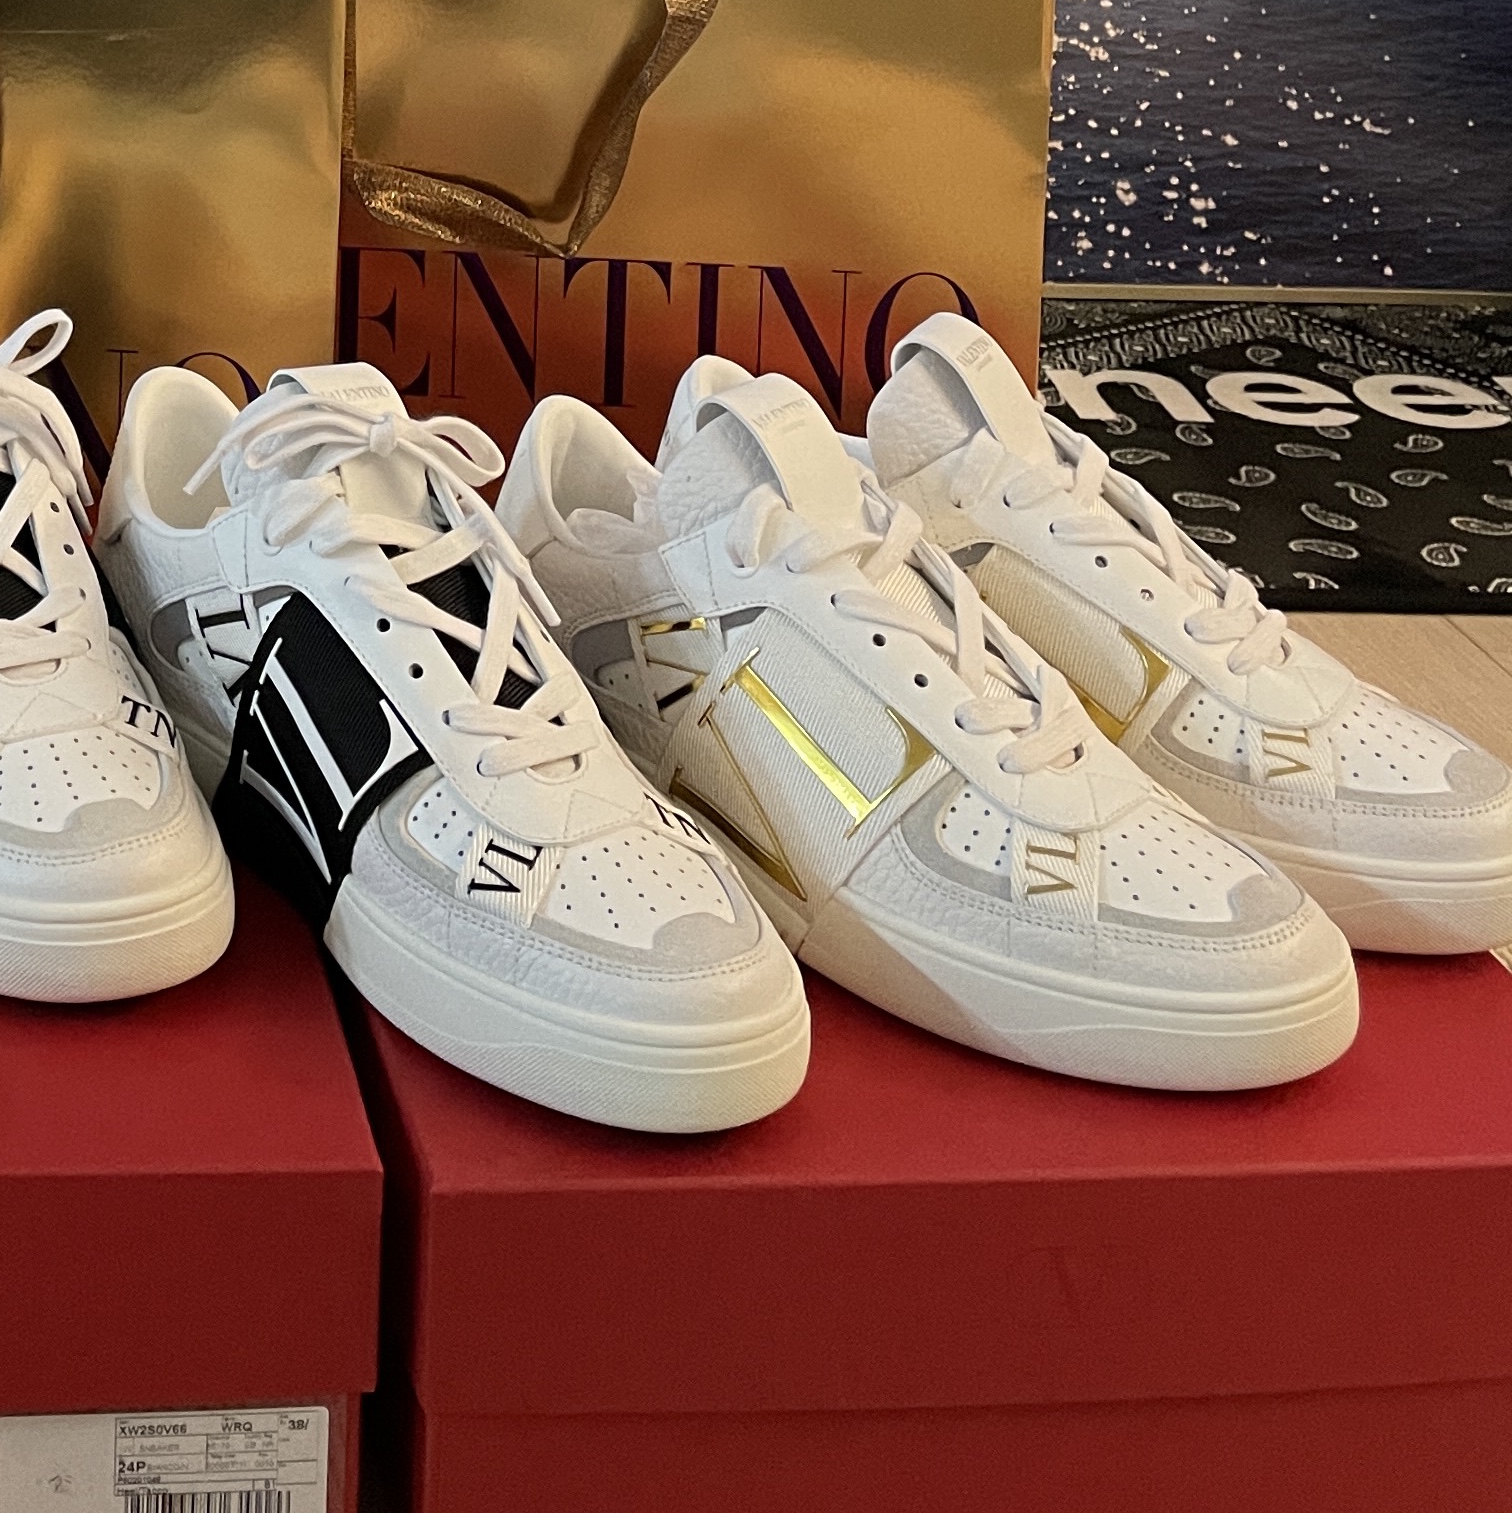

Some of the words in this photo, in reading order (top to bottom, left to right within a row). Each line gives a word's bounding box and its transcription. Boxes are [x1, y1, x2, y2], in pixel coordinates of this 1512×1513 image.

[1045, 367, 1512, 429] nee
[221, 1421, 253, 1432] WRQ
[118, 1461, 146, 1473] 24P
